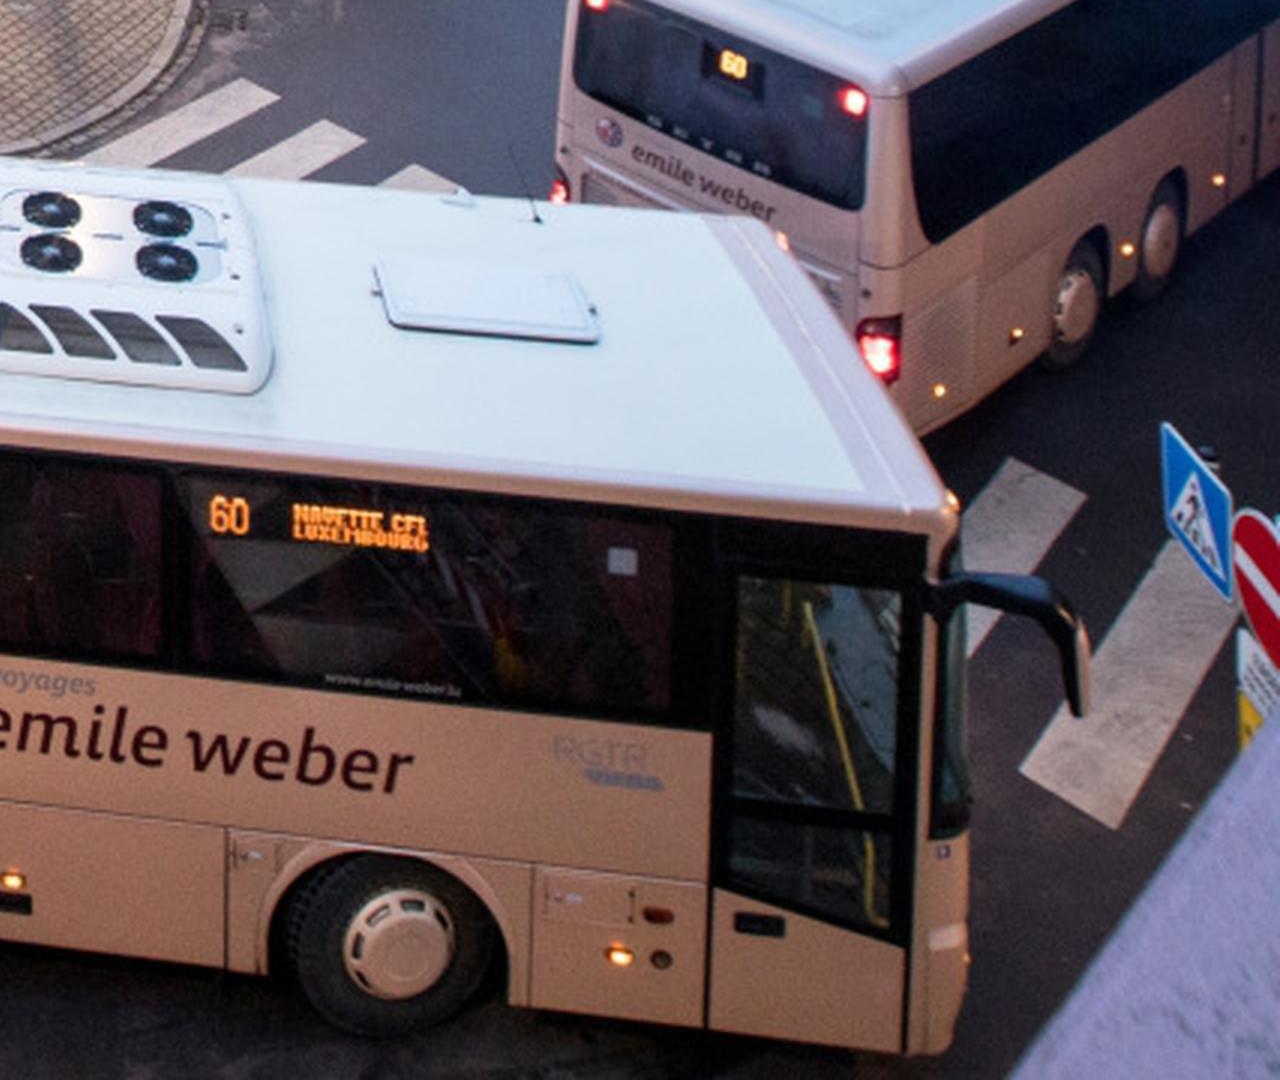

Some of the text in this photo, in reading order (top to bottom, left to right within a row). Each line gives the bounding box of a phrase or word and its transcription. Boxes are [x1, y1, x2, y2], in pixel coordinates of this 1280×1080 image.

[719, 49, 748, 79] 60
[631, 142, 695, 187] emile
[699, 173, 777, 222] weber
[209, 494, 251, 535] 60
[292, 503, 384, 531] NAVETTE
[186, 726, 415, 795] weber
